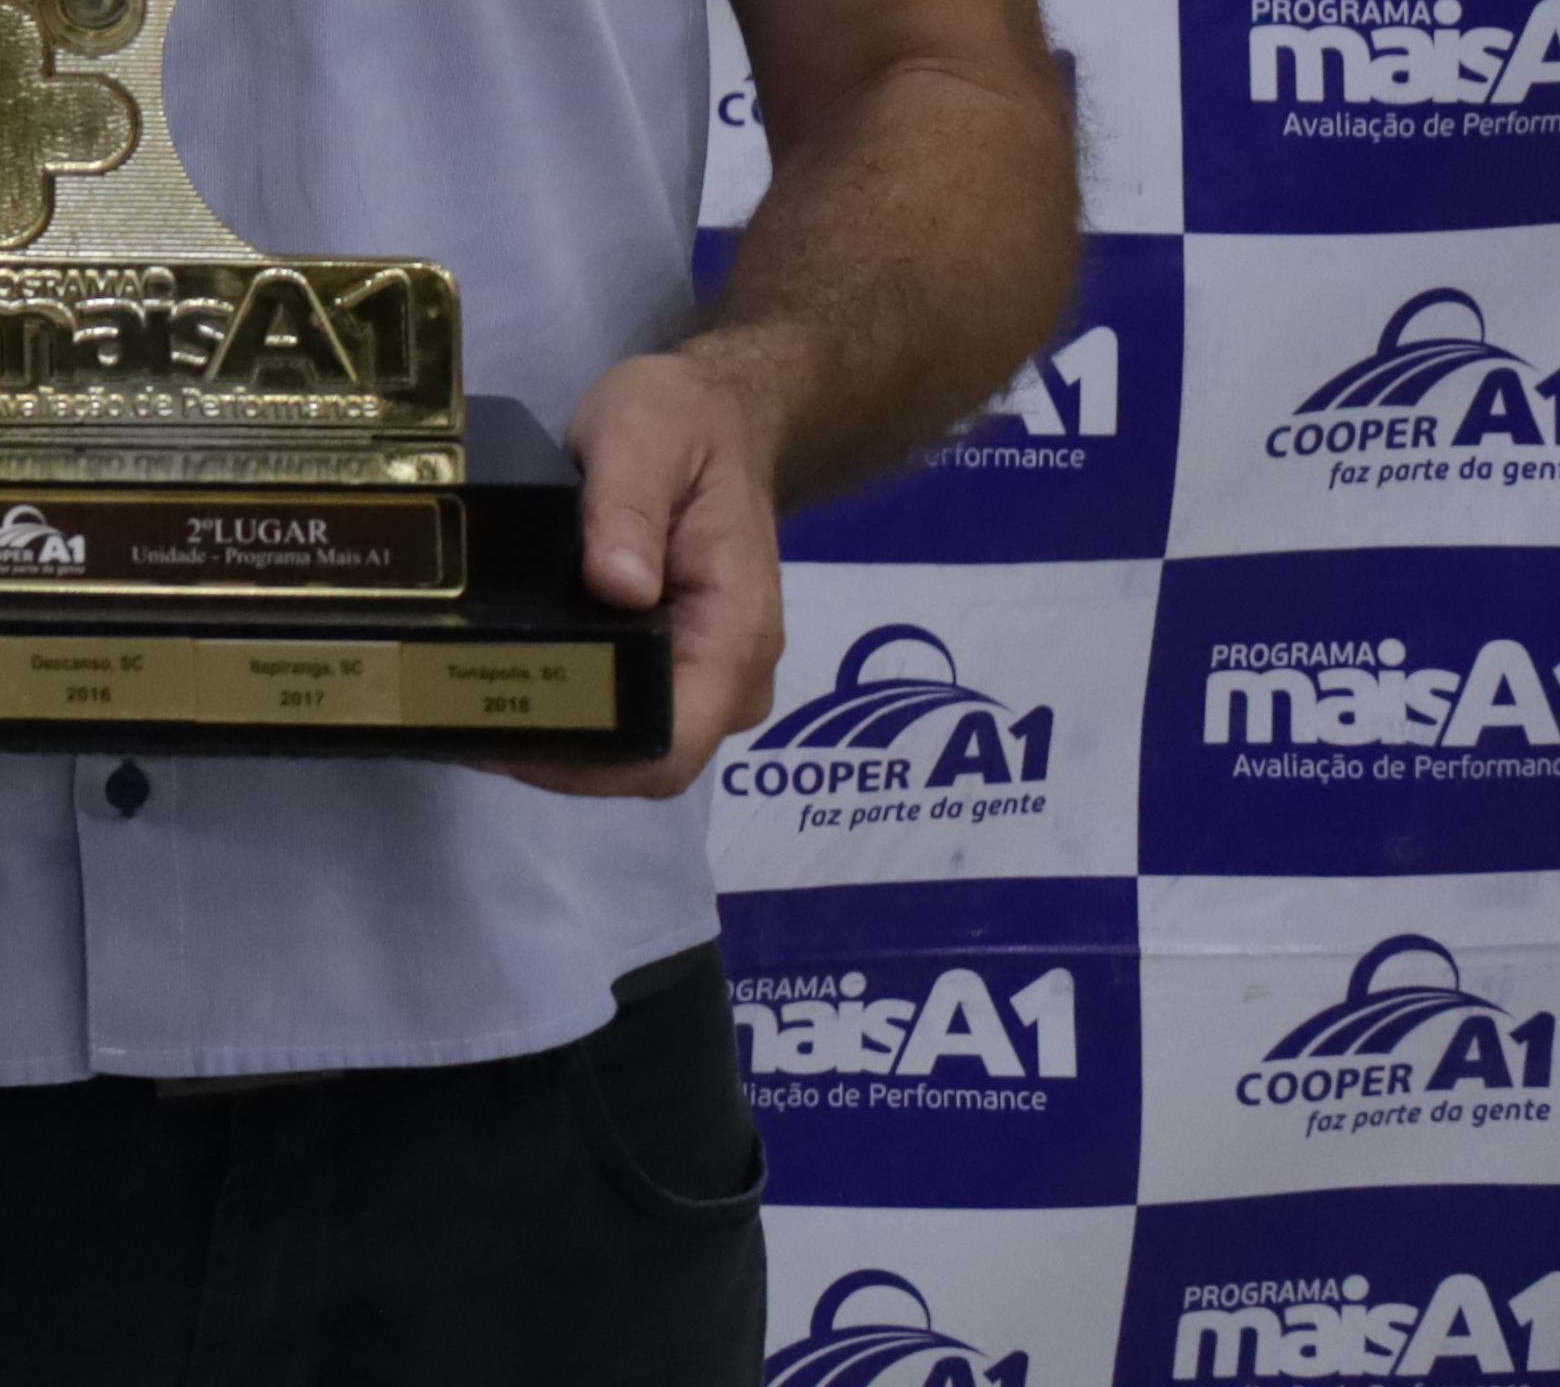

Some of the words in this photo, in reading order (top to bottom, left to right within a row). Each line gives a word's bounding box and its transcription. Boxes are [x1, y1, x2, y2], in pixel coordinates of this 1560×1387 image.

[131, 385, 174, 418] de
[181, 386, 381, 419] Performance
[37, 534, 86, 564] A1
[131, 545, 207, 566] Unidade
[225, 549, 311, 570] Programa
[317, 548, 361, 567] Mais
[365, 549, 391, 567] A1
[279, 690, 325, 707] 2017
[721, 758, 911, 798] COOPER
[924, 704, 1054, 789] A1
[798, 802, 841, 834] faz
[850, 798, 921, 831] parte
[929, 795, 963, 822] da
[971, 791, 1046, 825] gente
